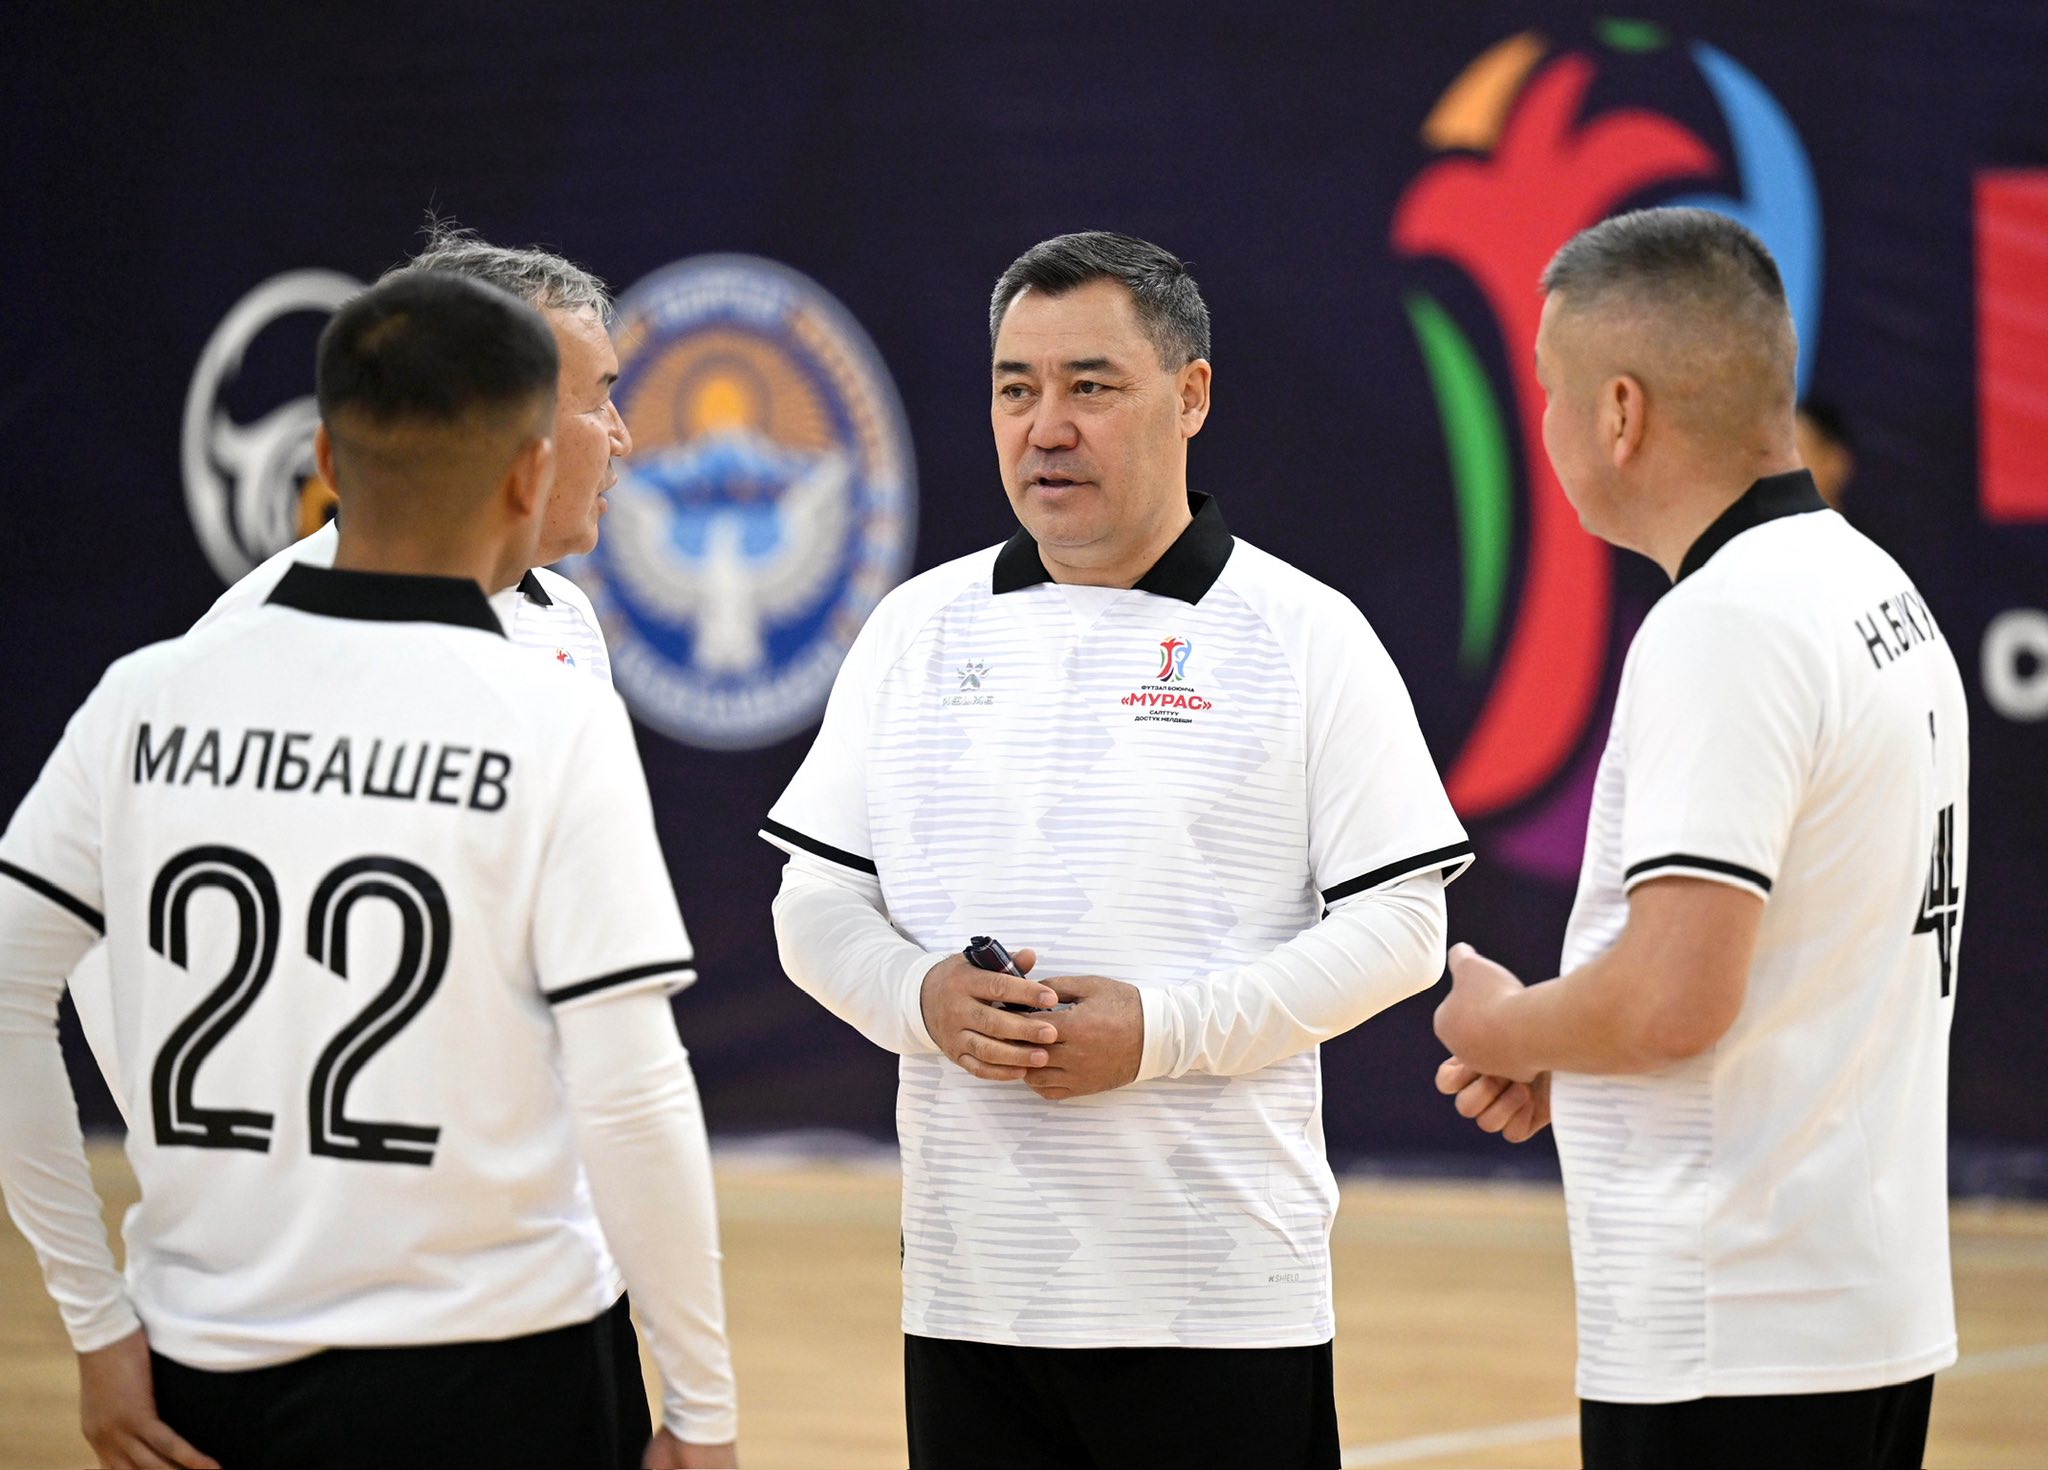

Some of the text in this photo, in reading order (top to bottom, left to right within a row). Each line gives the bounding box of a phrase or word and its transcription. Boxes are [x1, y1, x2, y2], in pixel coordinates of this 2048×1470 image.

[1121, 692, 1212, 711] «МУРАС»
[1149, 709, 1180, 717] САЛТТУУ
[1161, 716, 1193, 724] МЕЛДЕШИ
[133, 722, 513, 813] МАЛБАШЕВ
[149, 844, 452, 1167] 22
